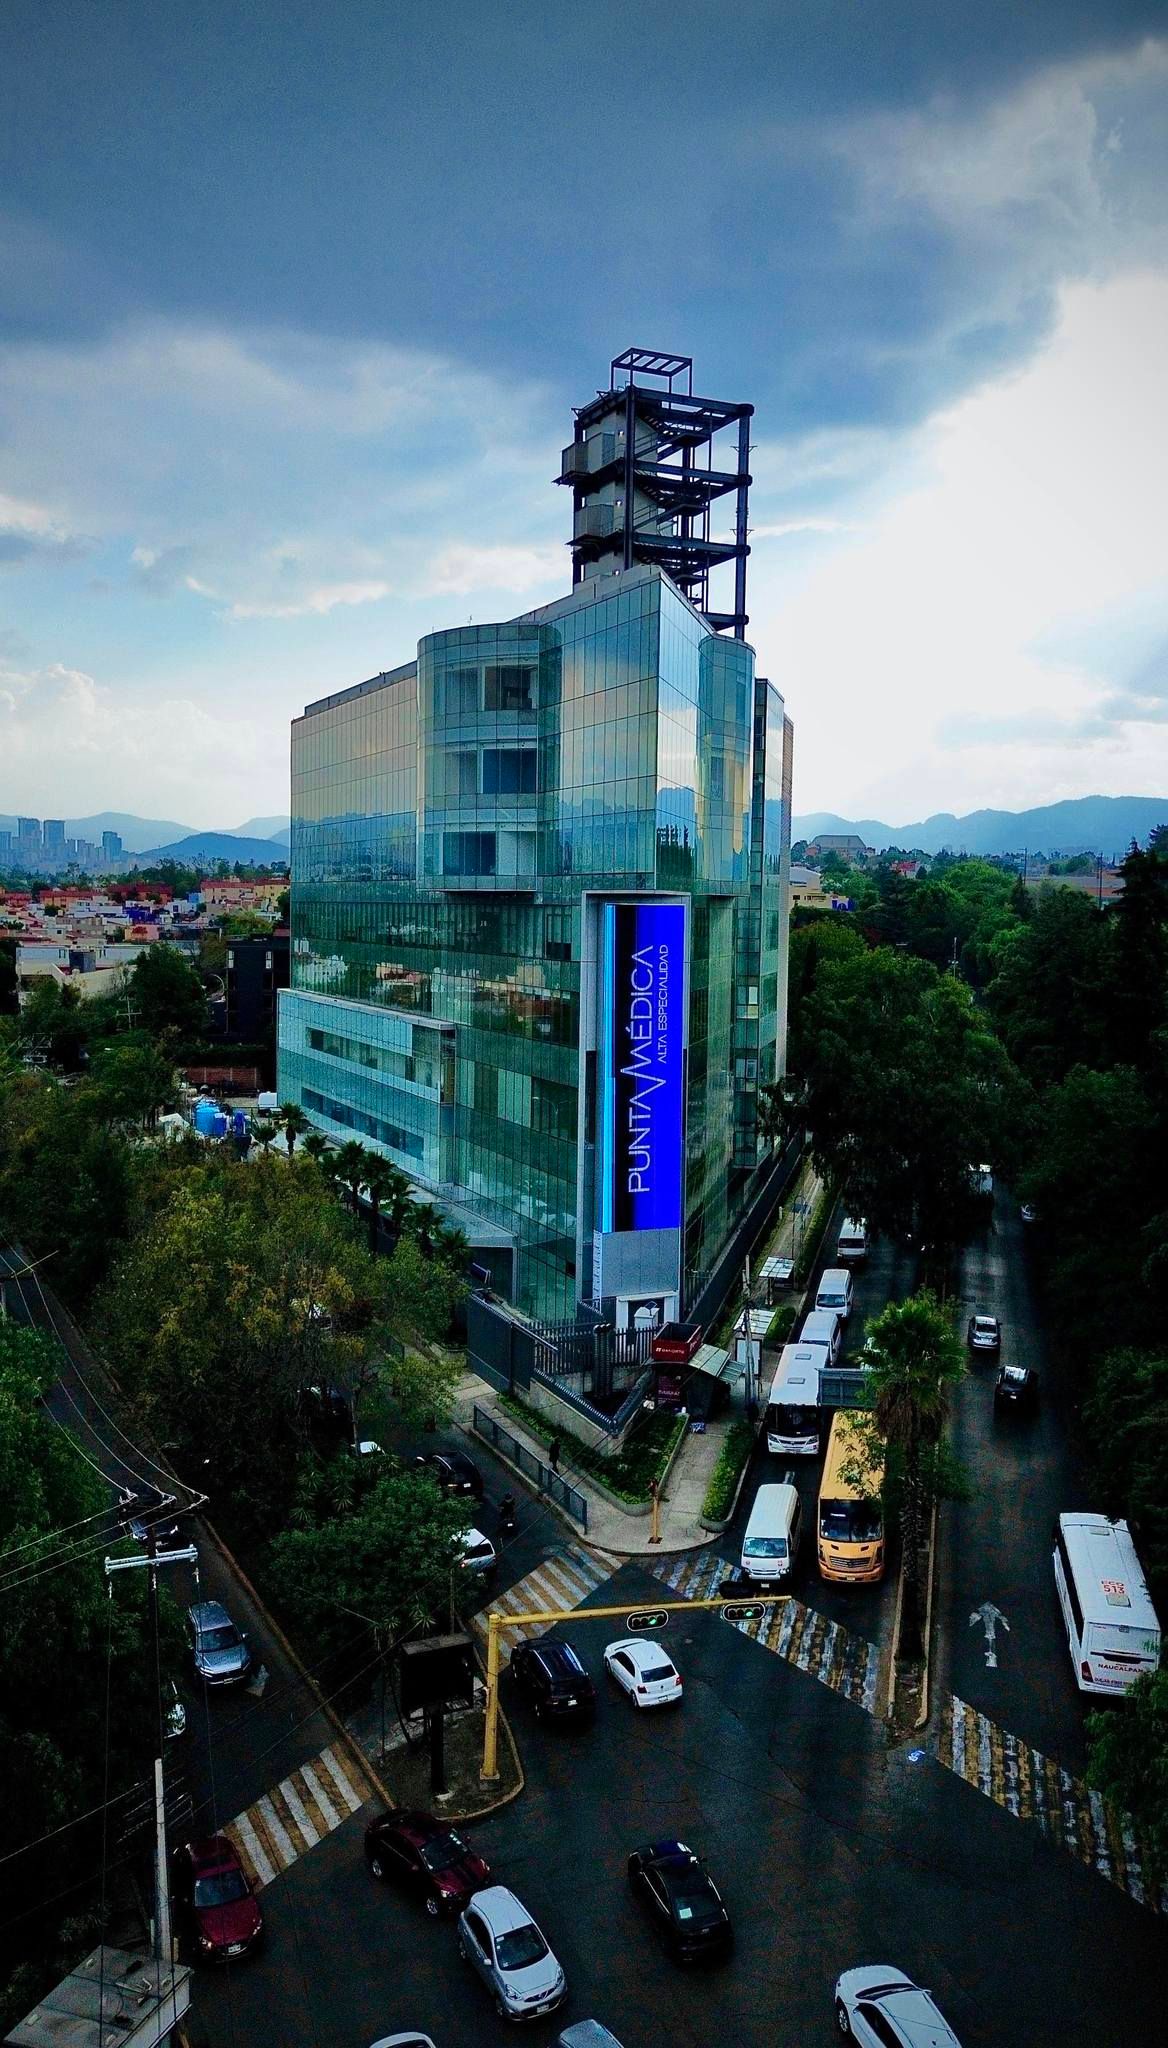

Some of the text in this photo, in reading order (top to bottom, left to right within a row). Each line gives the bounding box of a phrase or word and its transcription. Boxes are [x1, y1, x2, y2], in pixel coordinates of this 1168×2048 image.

[657, 944, 669, 1064] ALTA ESPECIALIDAD
[620, 945, 666, 1192] PUNTA MÉDICA
[1103, 1584, 1125, 1594] 513
[1098, 1663, 1144, 1673] NAUCALPAN
